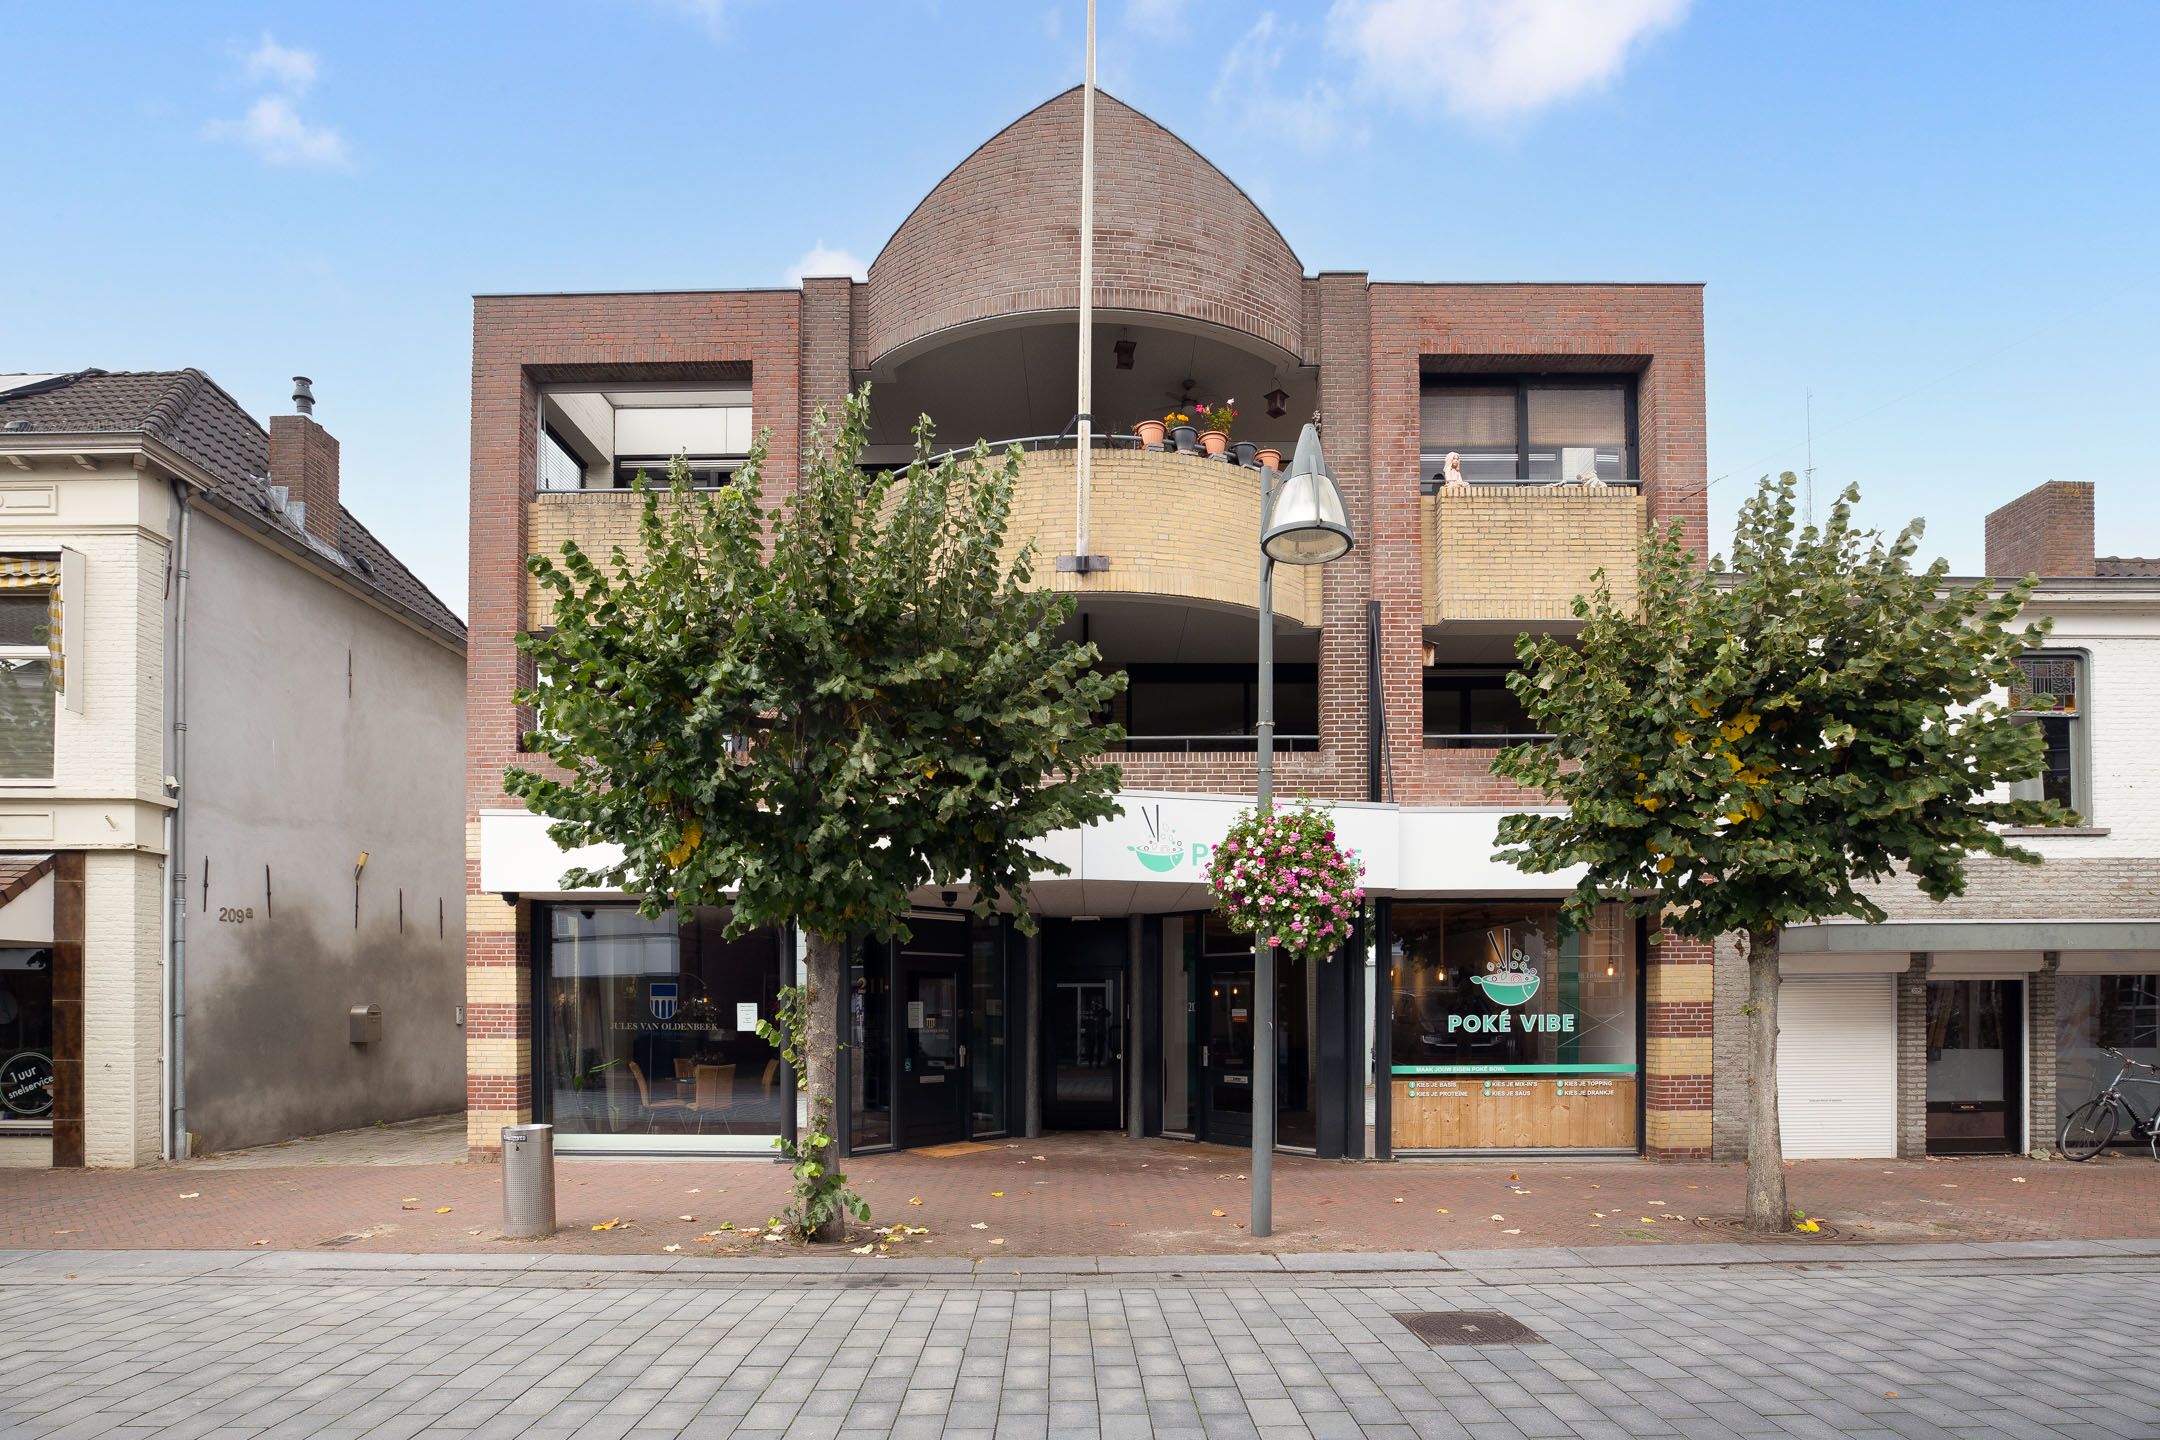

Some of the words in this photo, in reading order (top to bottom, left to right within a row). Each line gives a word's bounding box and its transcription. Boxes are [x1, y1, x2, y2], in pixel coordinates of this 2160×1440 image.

[609, 1022, 638, 1030] JULES
[640, 1022, 659, 1030] VAN
[661, 1022, 719, 1031] OLDENBEEK
[1447, 1008, 1512, 1033] POKÉ
[1519, 1013, 1575, 1033] VIBE
[10, 1072, 18, 1084] 1
[17, 1066, 37, 1081] uur
[8, 1075, 54, 1100] snelservice
